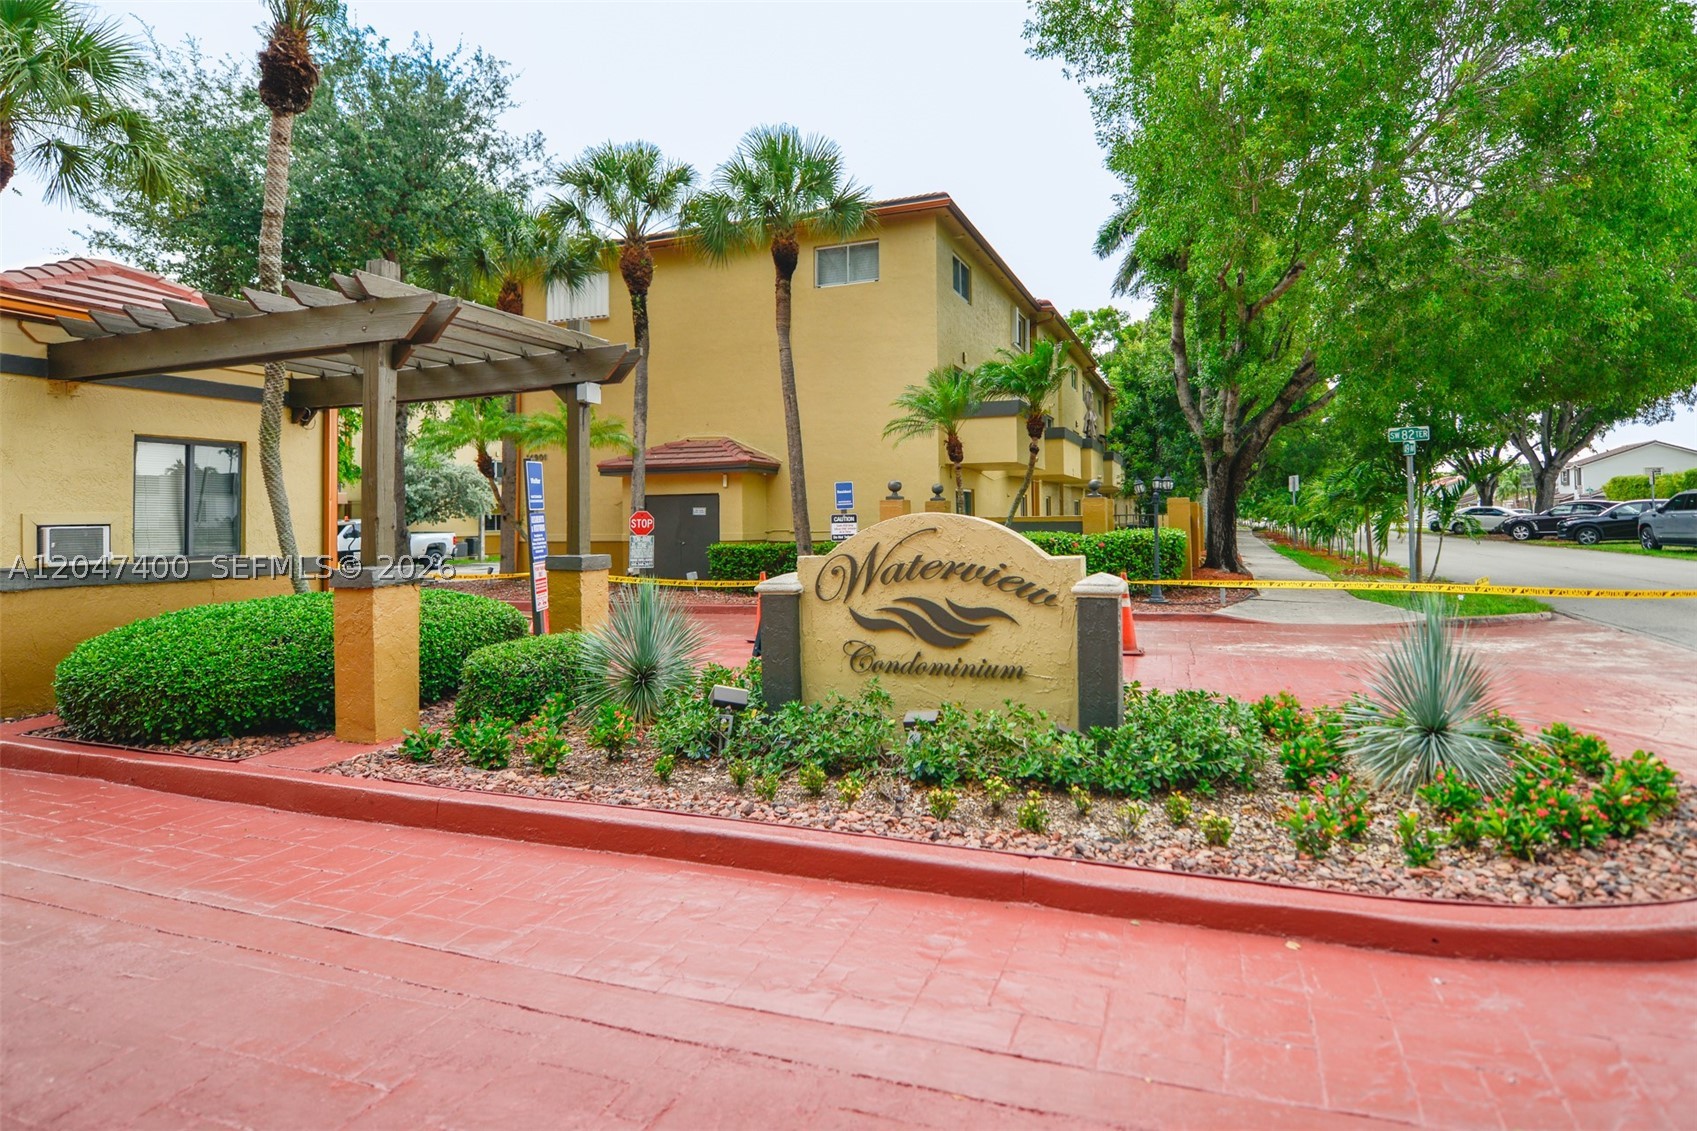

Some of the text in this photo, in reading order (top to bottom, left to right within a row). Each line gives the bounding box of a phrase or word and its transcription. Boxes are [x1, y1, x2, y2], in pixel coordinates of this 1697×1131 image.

[1402, 430, 1415, 440] 82
[630, 519, 653, 528] STOP
[815, 528, 1058, 606] Waterview
[843, 640, 1025, 679] Condominium
